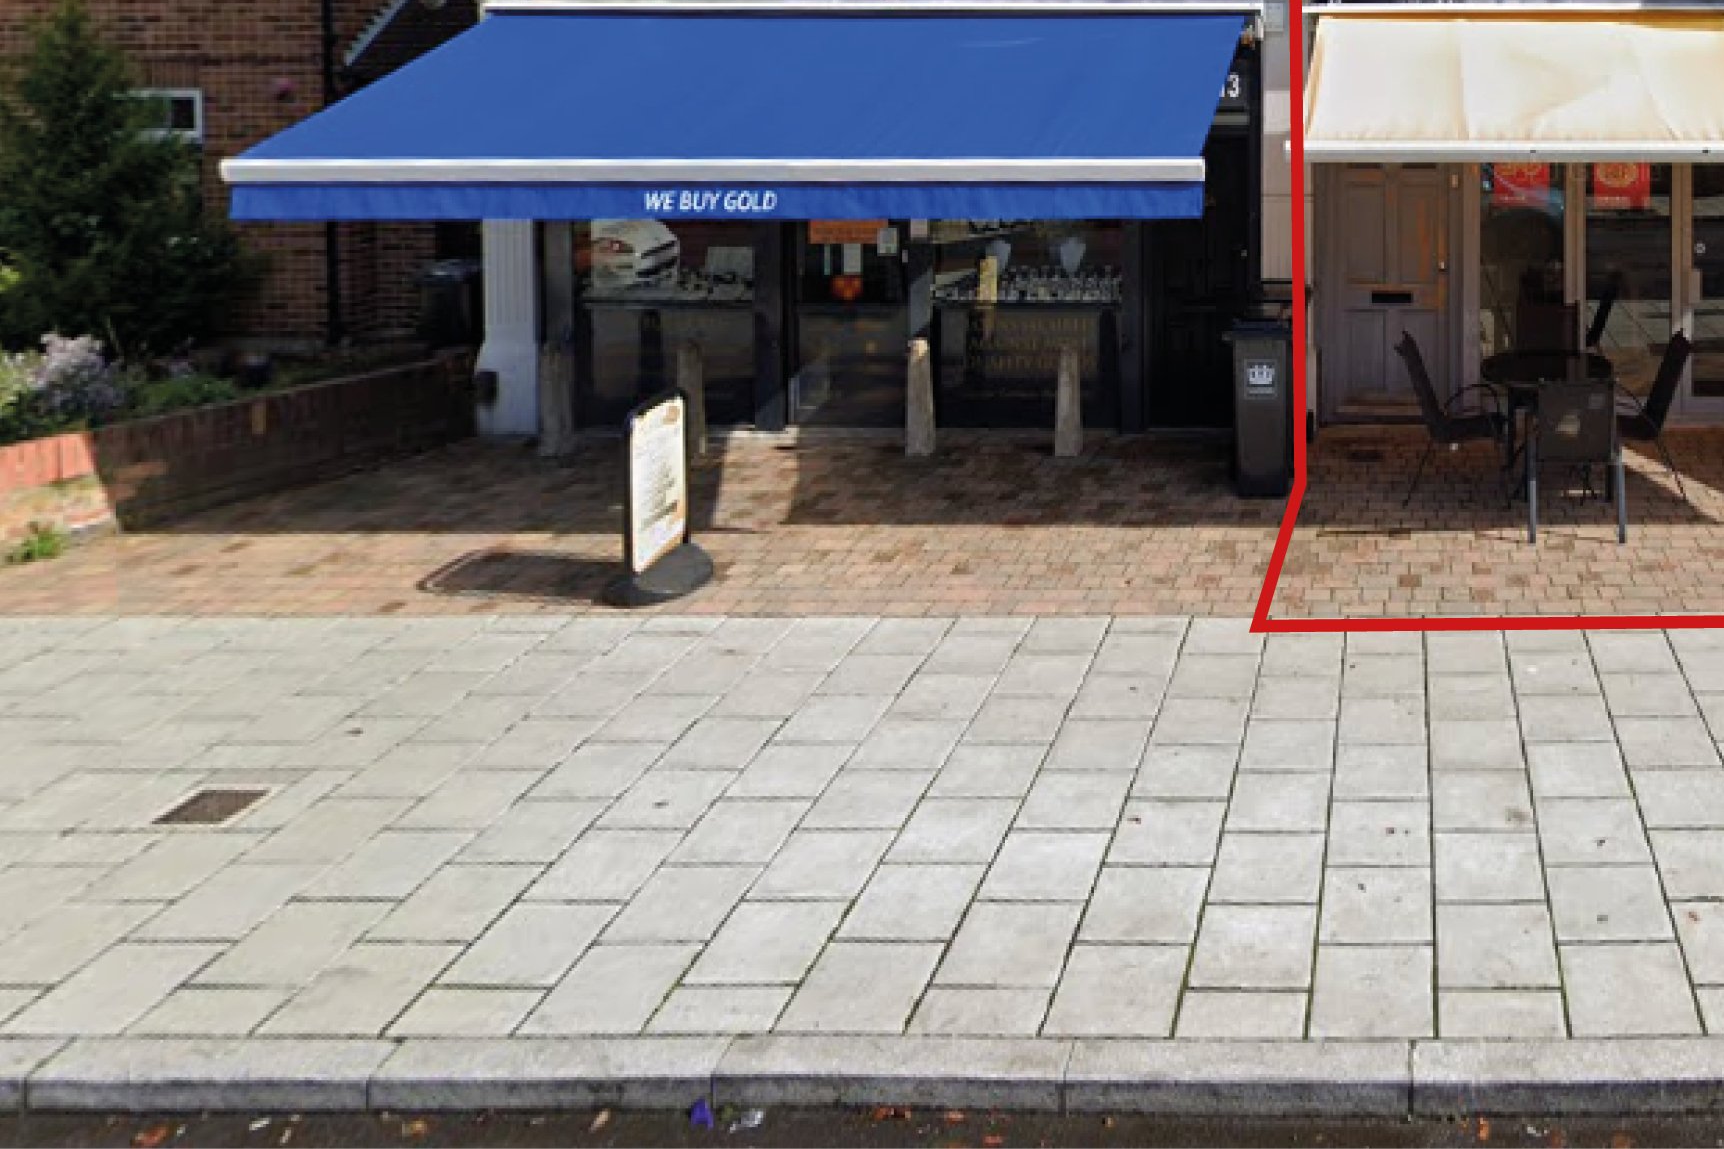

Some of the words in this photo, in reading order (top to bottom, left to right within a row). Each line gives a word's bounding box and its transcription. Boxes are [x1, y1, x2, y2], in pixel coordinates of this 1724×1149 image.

[644, 190, 677, 211] WE
[679, 190, 721, 211] BUY
[723, 190, 777, 212] GOLD
